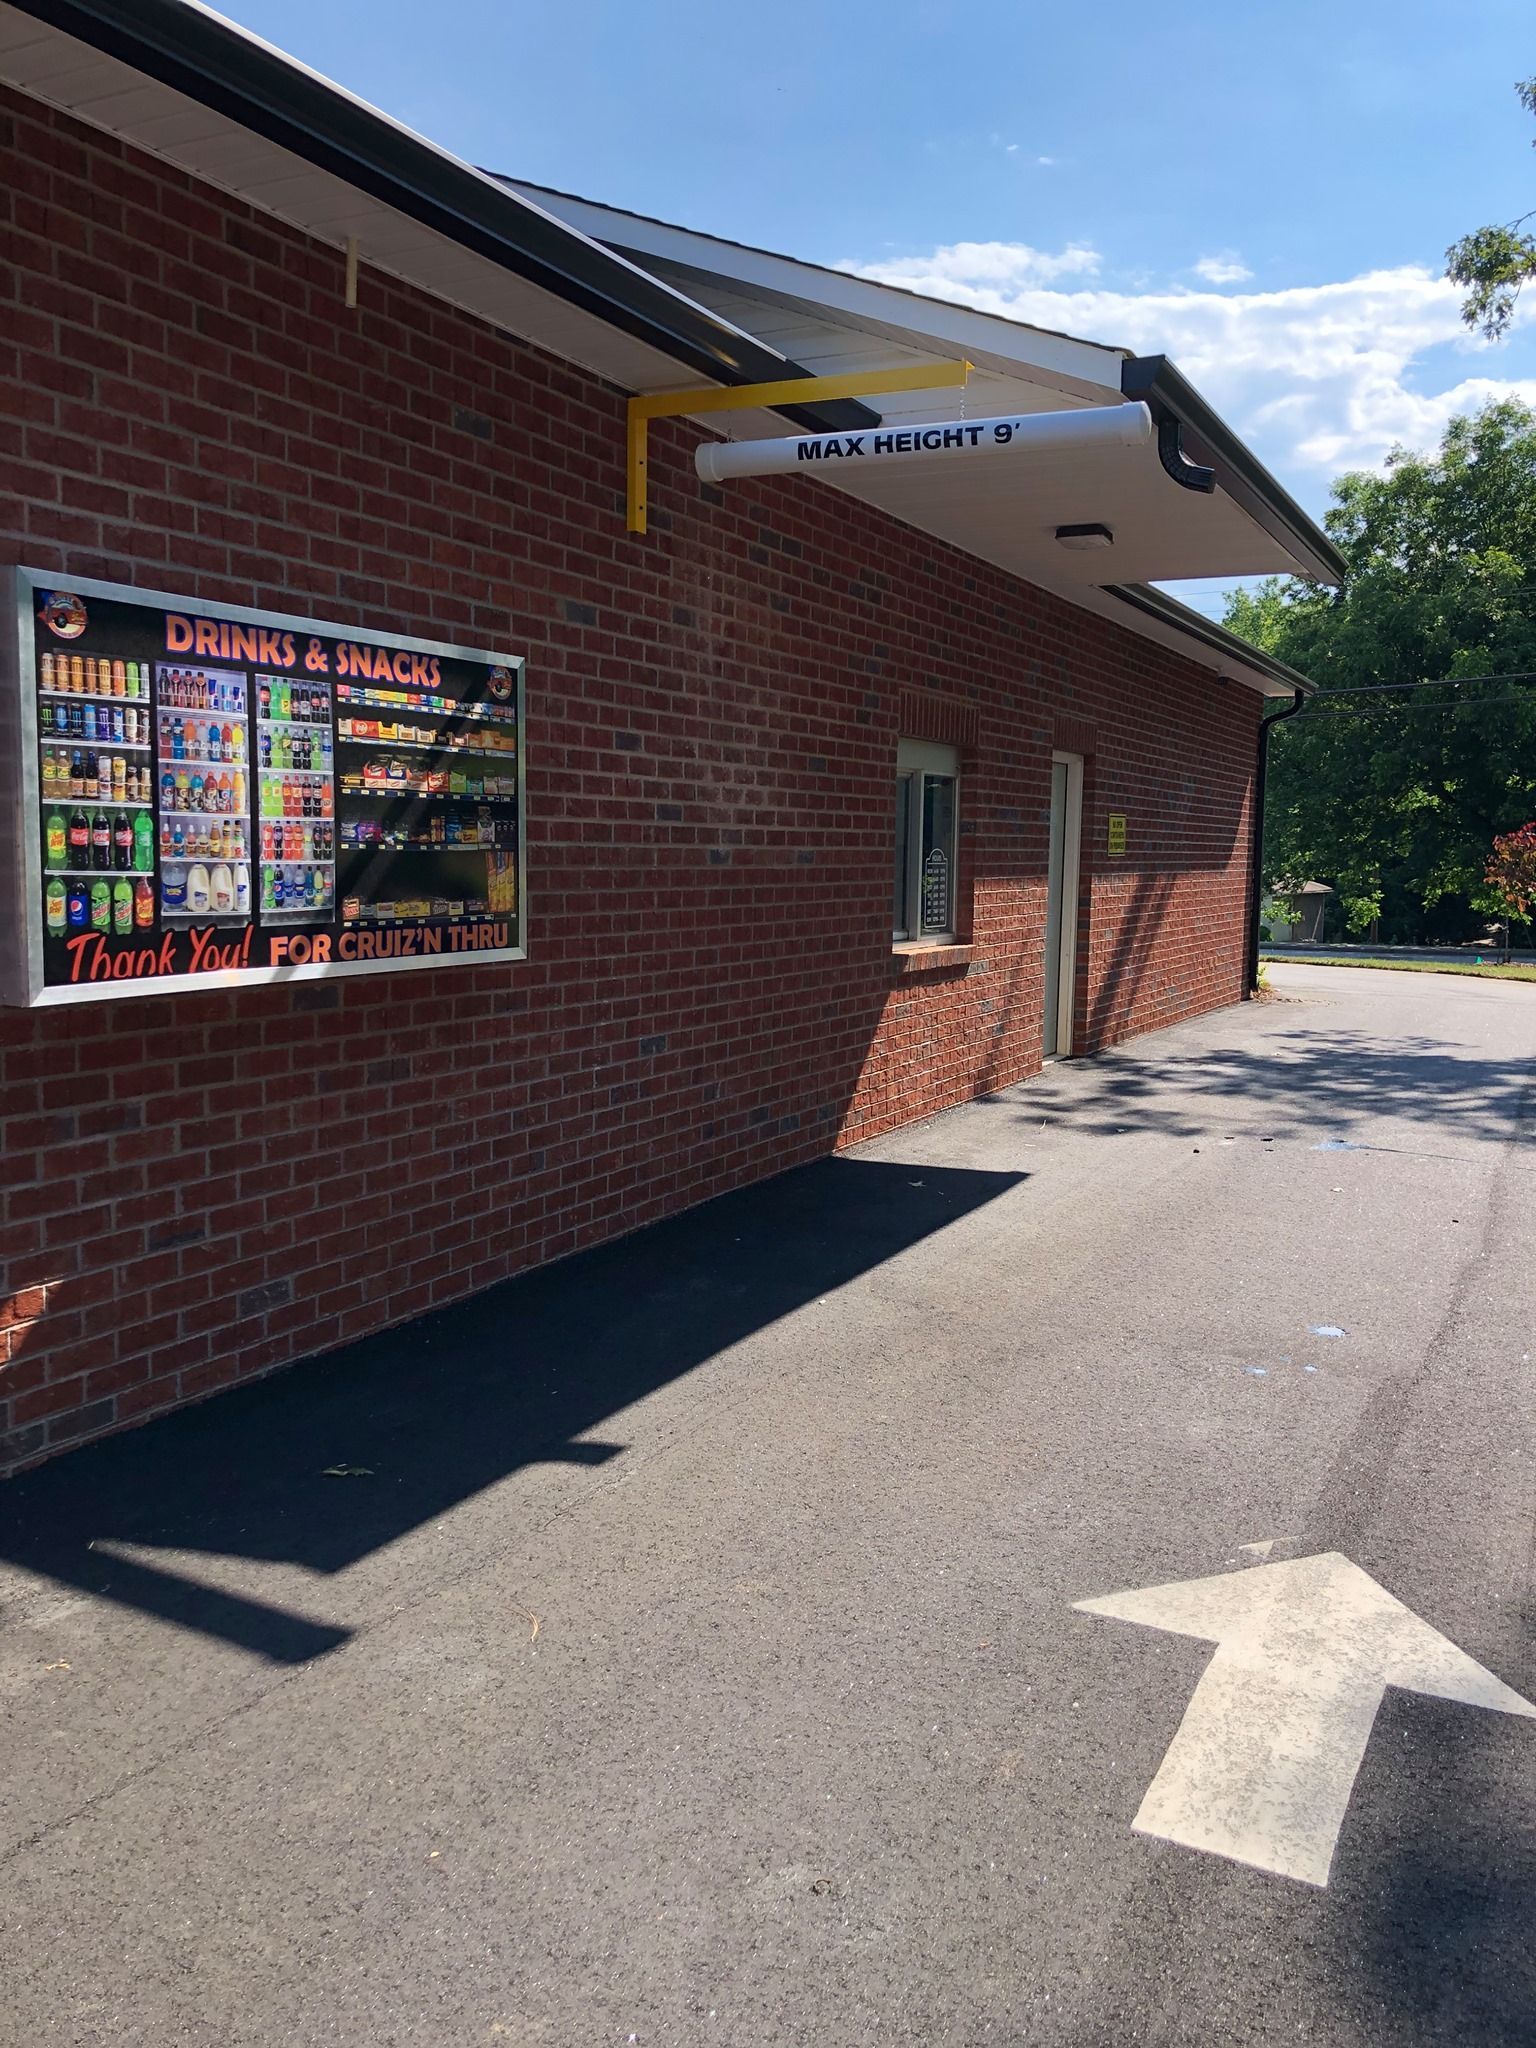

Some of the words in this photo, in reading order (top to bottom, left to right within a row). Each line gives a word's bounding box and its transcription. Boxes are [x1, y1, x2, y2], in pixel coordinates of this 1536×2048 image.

[797, 436, 866, 461] MAX
[874, 425, 985, 455] HEIGHT
[994, 422, 1022, 445] 9'
[165, 613, 297, 669] DRINKS
[305, 638, 329, 673] &
[336, 642, 442, 688] SNACKS
[66, 931, 176, 982] Thank
[188, 923, 254, 973] You!
[270, 933, 331, 966] FOR
[338, 926, 442, 961] CRUIZ'N
[448, 923, 508, 951] THRU
